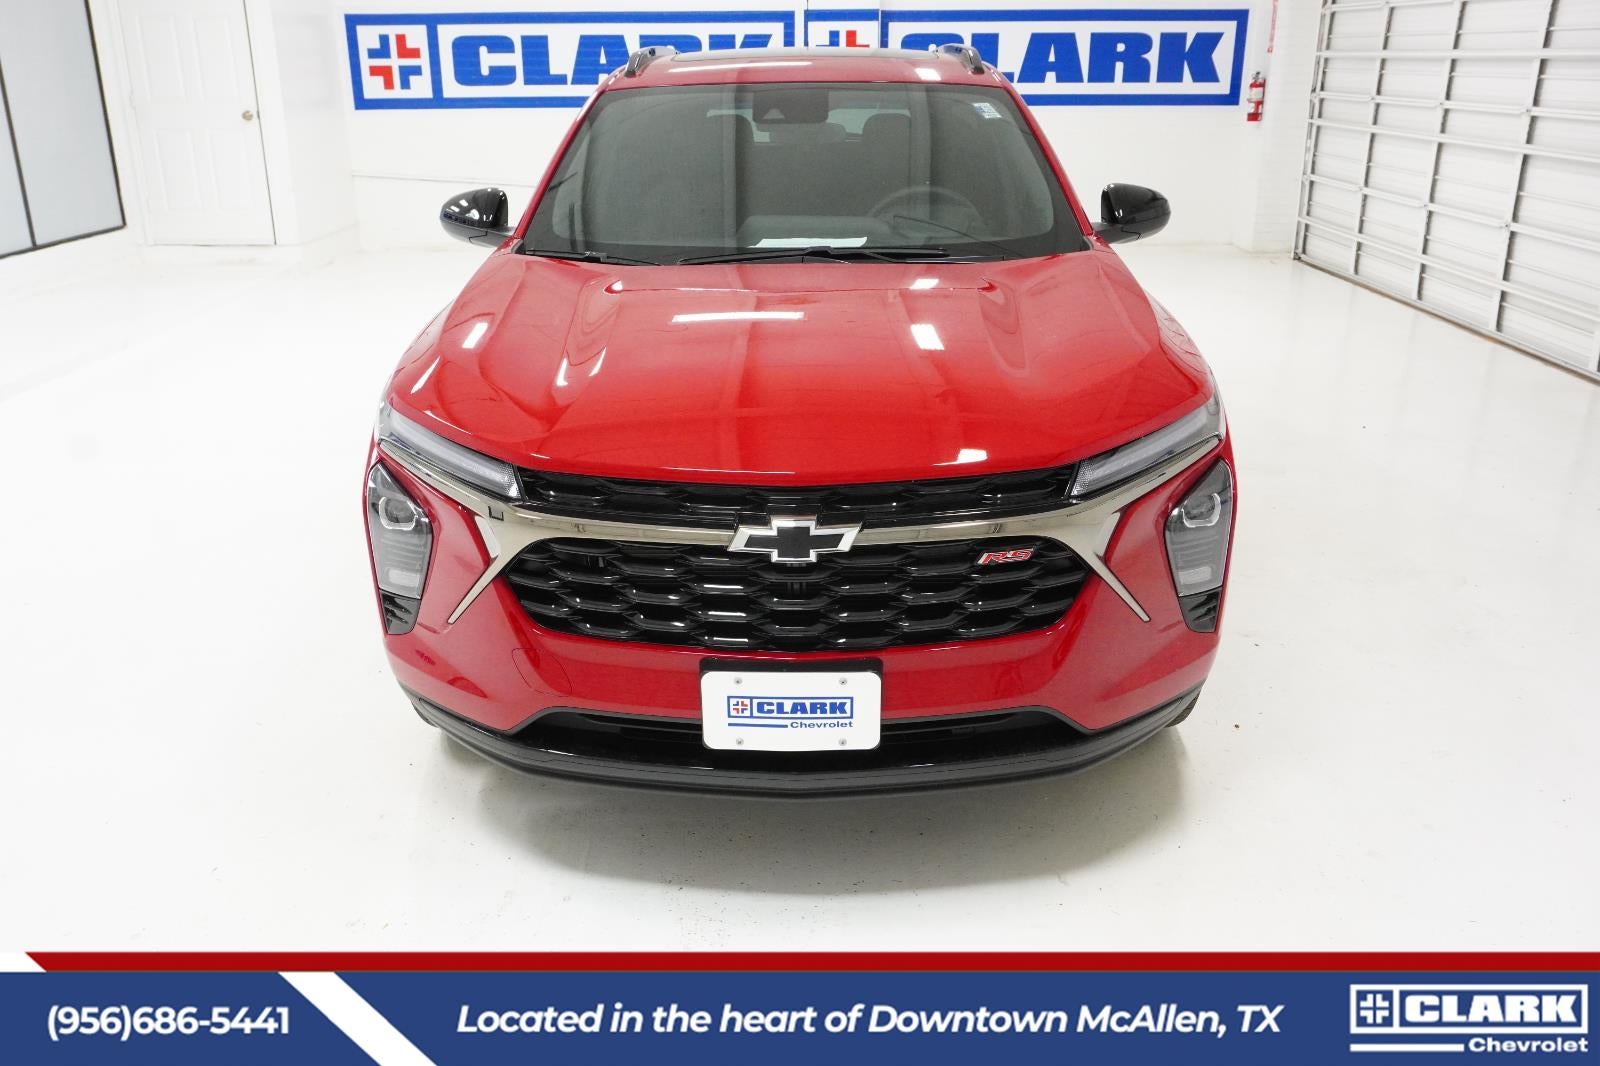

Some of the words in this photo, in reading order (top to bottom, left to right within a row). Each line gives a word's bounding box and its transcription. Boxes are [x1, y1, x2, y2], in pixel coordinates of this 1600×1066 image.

[451, 33, 773, 87] CLA
[977, 548, 1034, 566] RS
[756, 701, 848, 715] CLARK
[790, 720, 854, 729] Chevrolet
